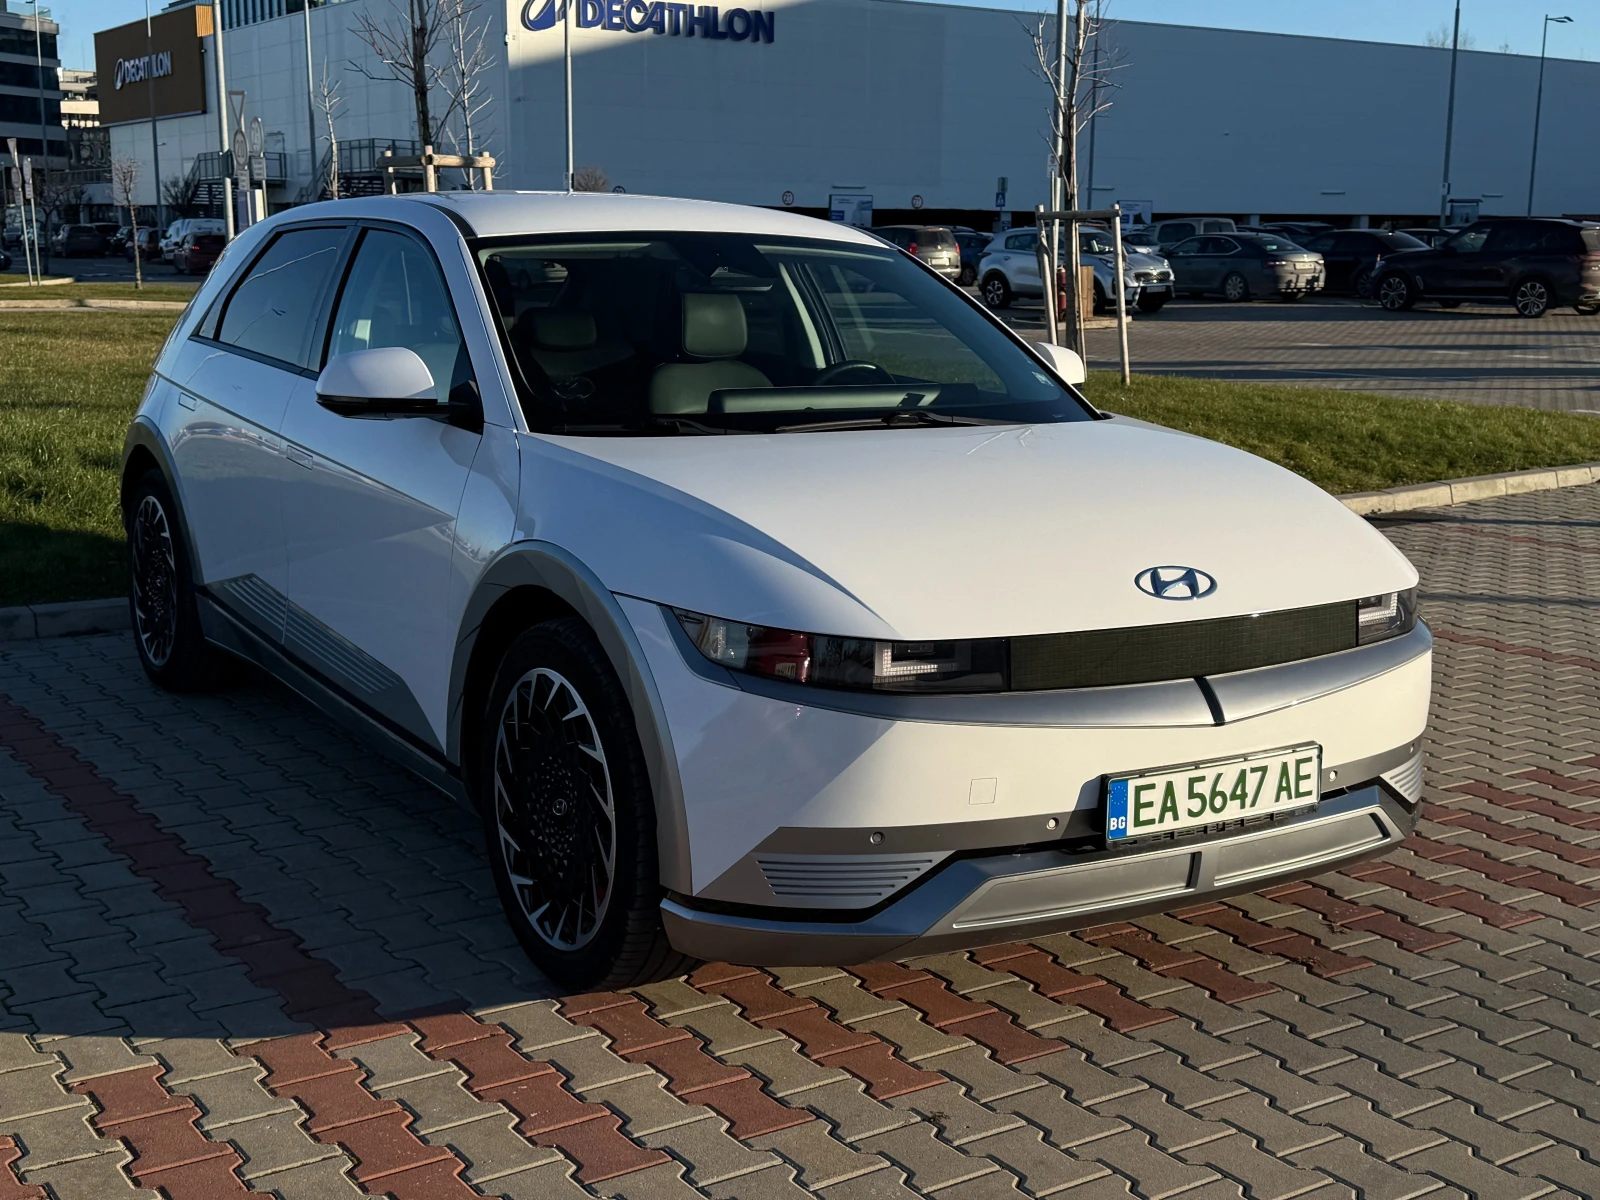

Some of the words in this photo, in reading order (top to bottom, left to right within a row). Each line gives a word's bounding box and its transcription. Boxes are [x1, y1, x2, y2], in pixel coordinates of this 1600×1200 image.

[576, 0, 775, 43] DECATHLON
[1110, 816, 1126, 831] BG
[1133, 780, 1180, 828] EA
[1187, 765, 1268, 818] 5647
[1274, 756, 1313, 803] AE
